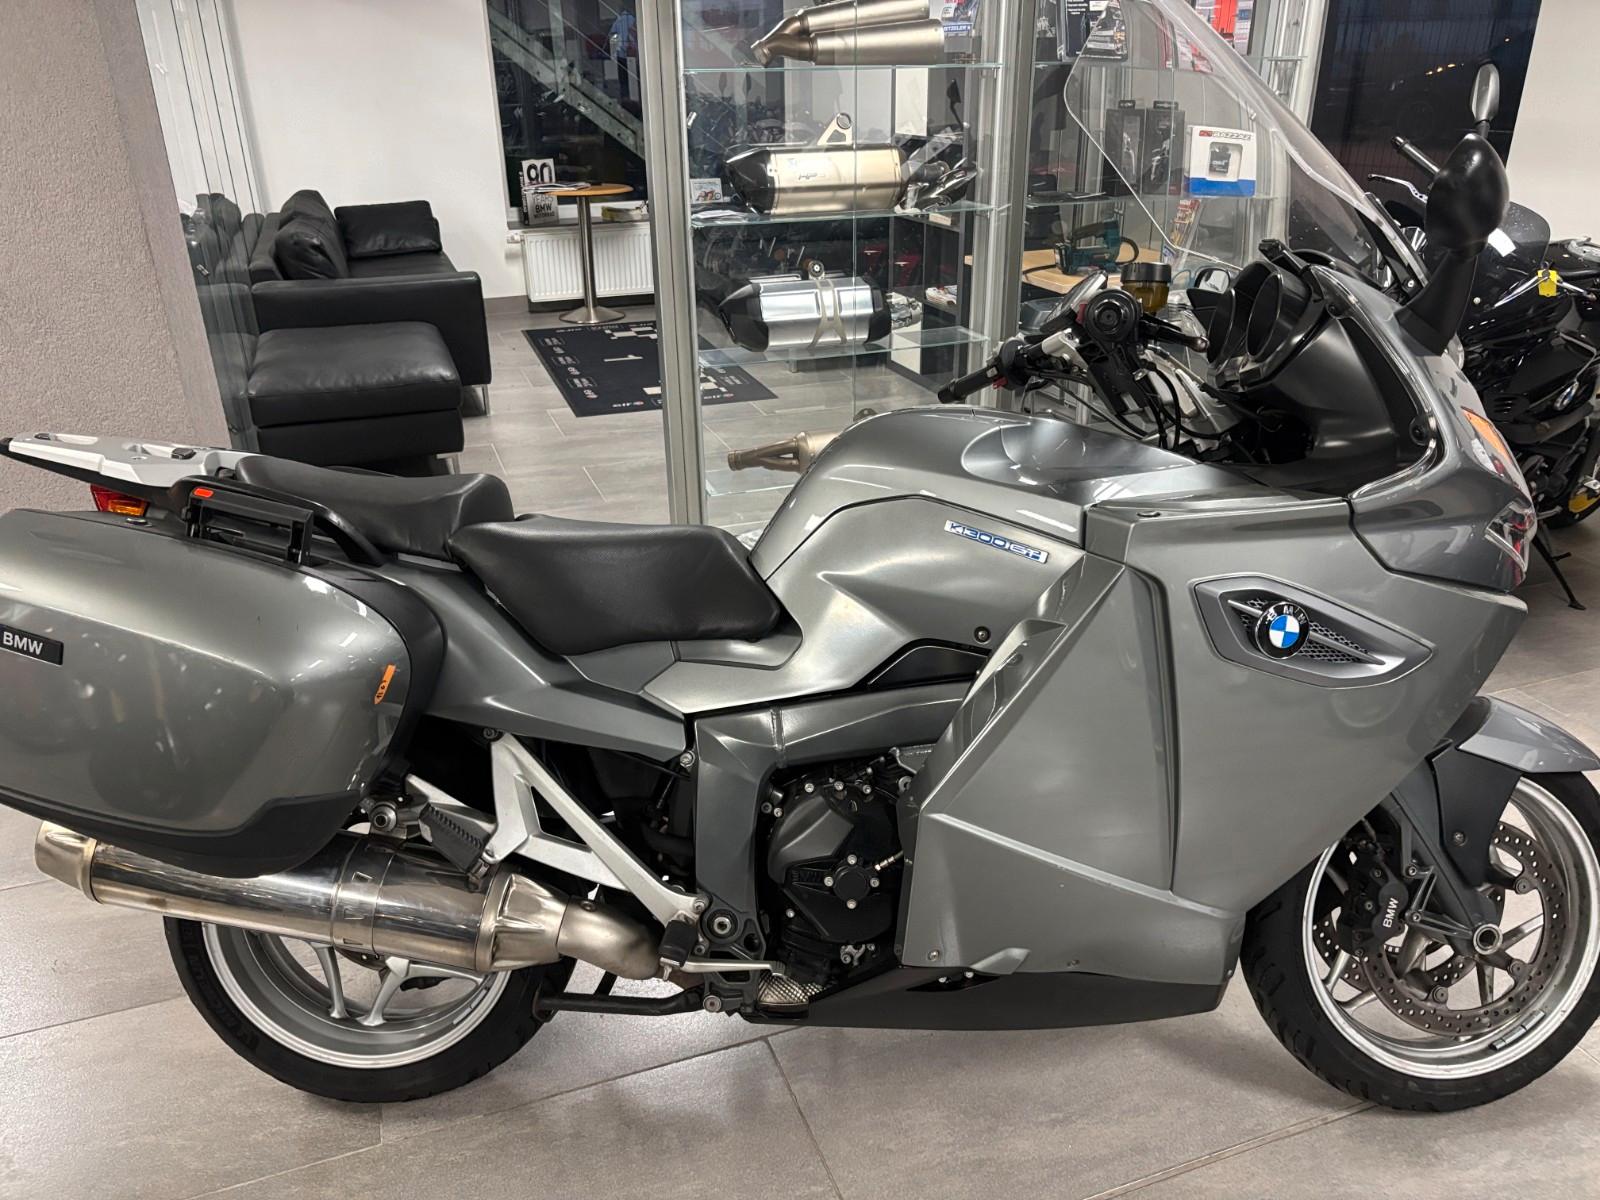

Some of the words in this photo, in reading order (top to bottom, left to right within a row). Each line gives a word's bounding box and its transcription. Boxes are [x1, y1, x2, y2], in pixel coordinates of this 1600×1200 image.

[535, 203, 552, 213] BMW
[1264, 605, 1307, 624] BMW
[3, 631, 43, 655] BMW
[1382, 897, 1399, 928] BMW
